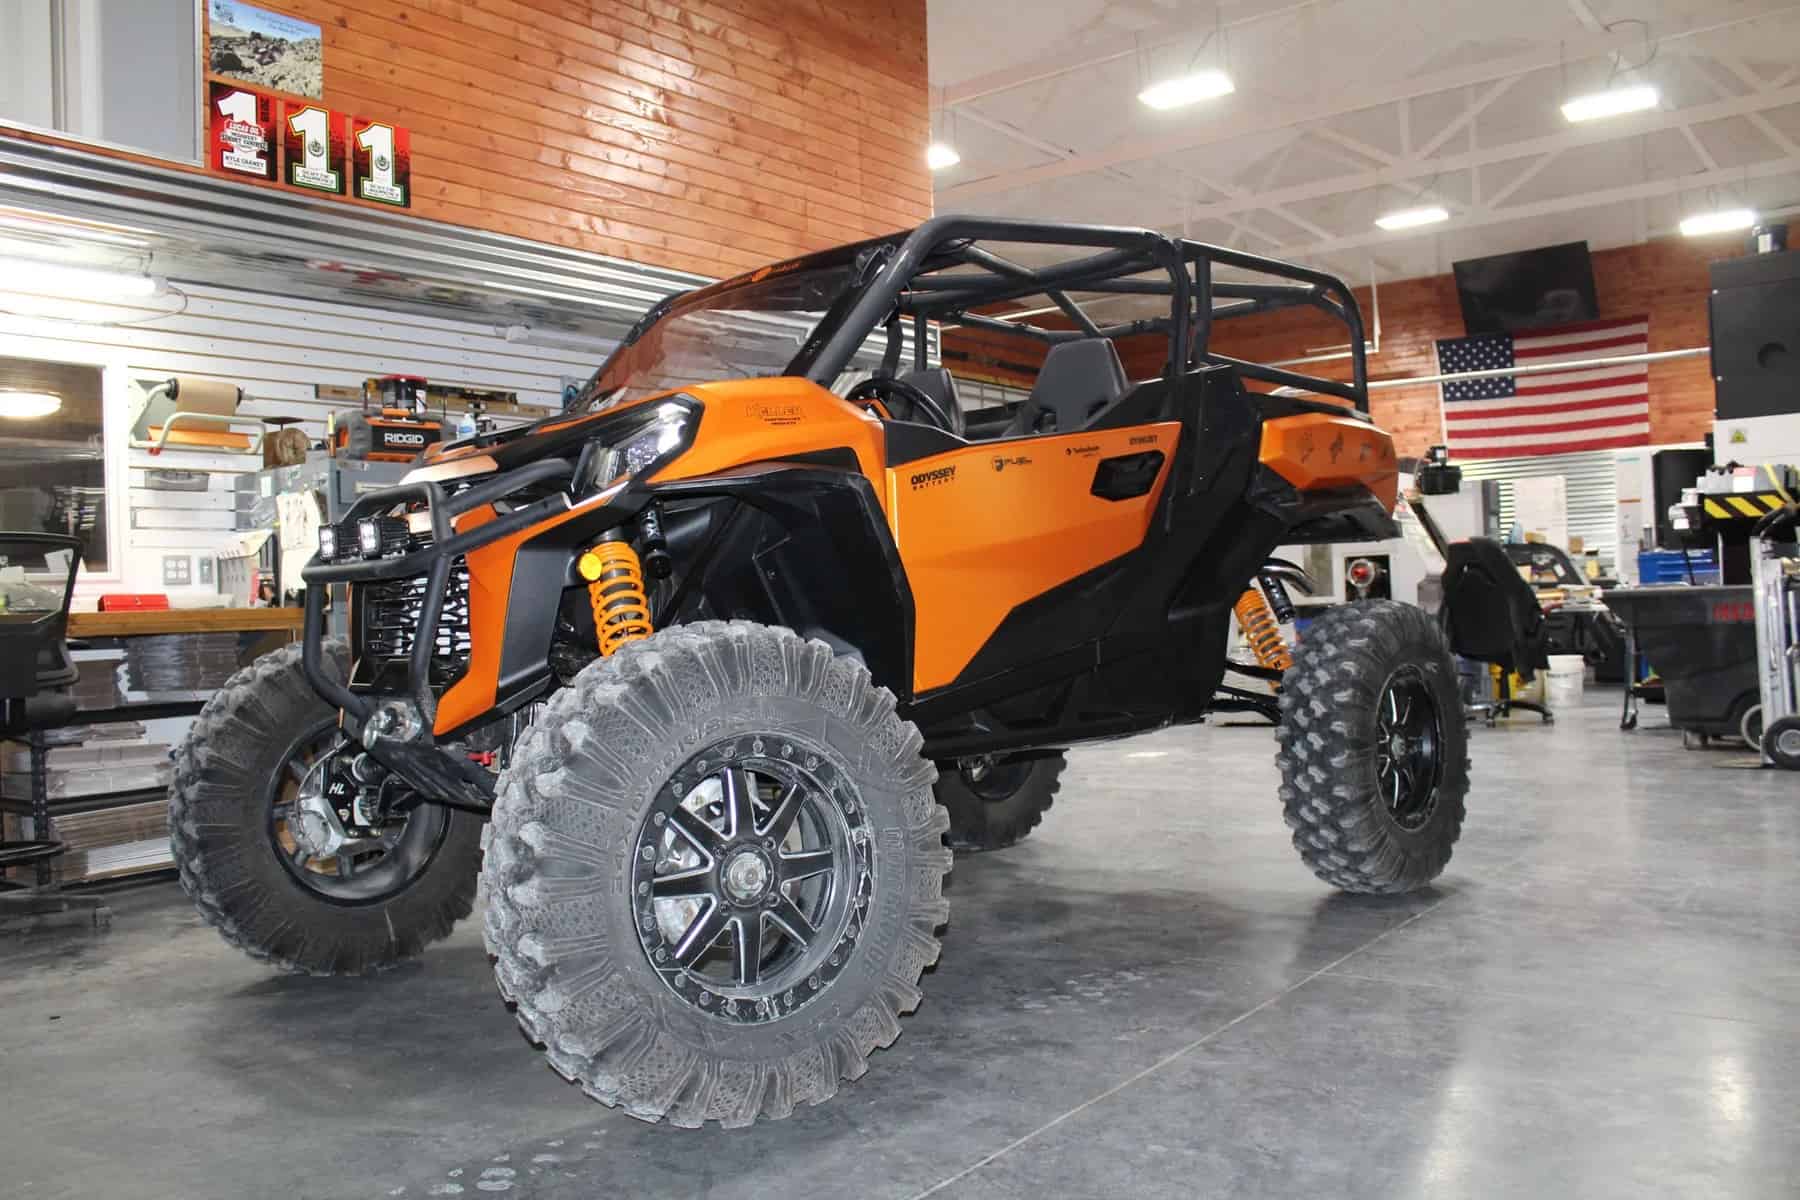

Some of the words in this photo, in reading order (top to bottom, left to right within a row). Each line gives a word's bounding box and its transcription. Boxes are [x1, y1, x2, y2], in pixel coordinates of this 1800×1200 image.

[217, 91, 267, 174] 1
[288, 106, 339, 192] 1
[356, 122, 405, 205] 1
[384, 432, 424, 444] RIDGID
[911, 464, 956, 485] ODYSSEY
[328, 782, 345, 795] HL
